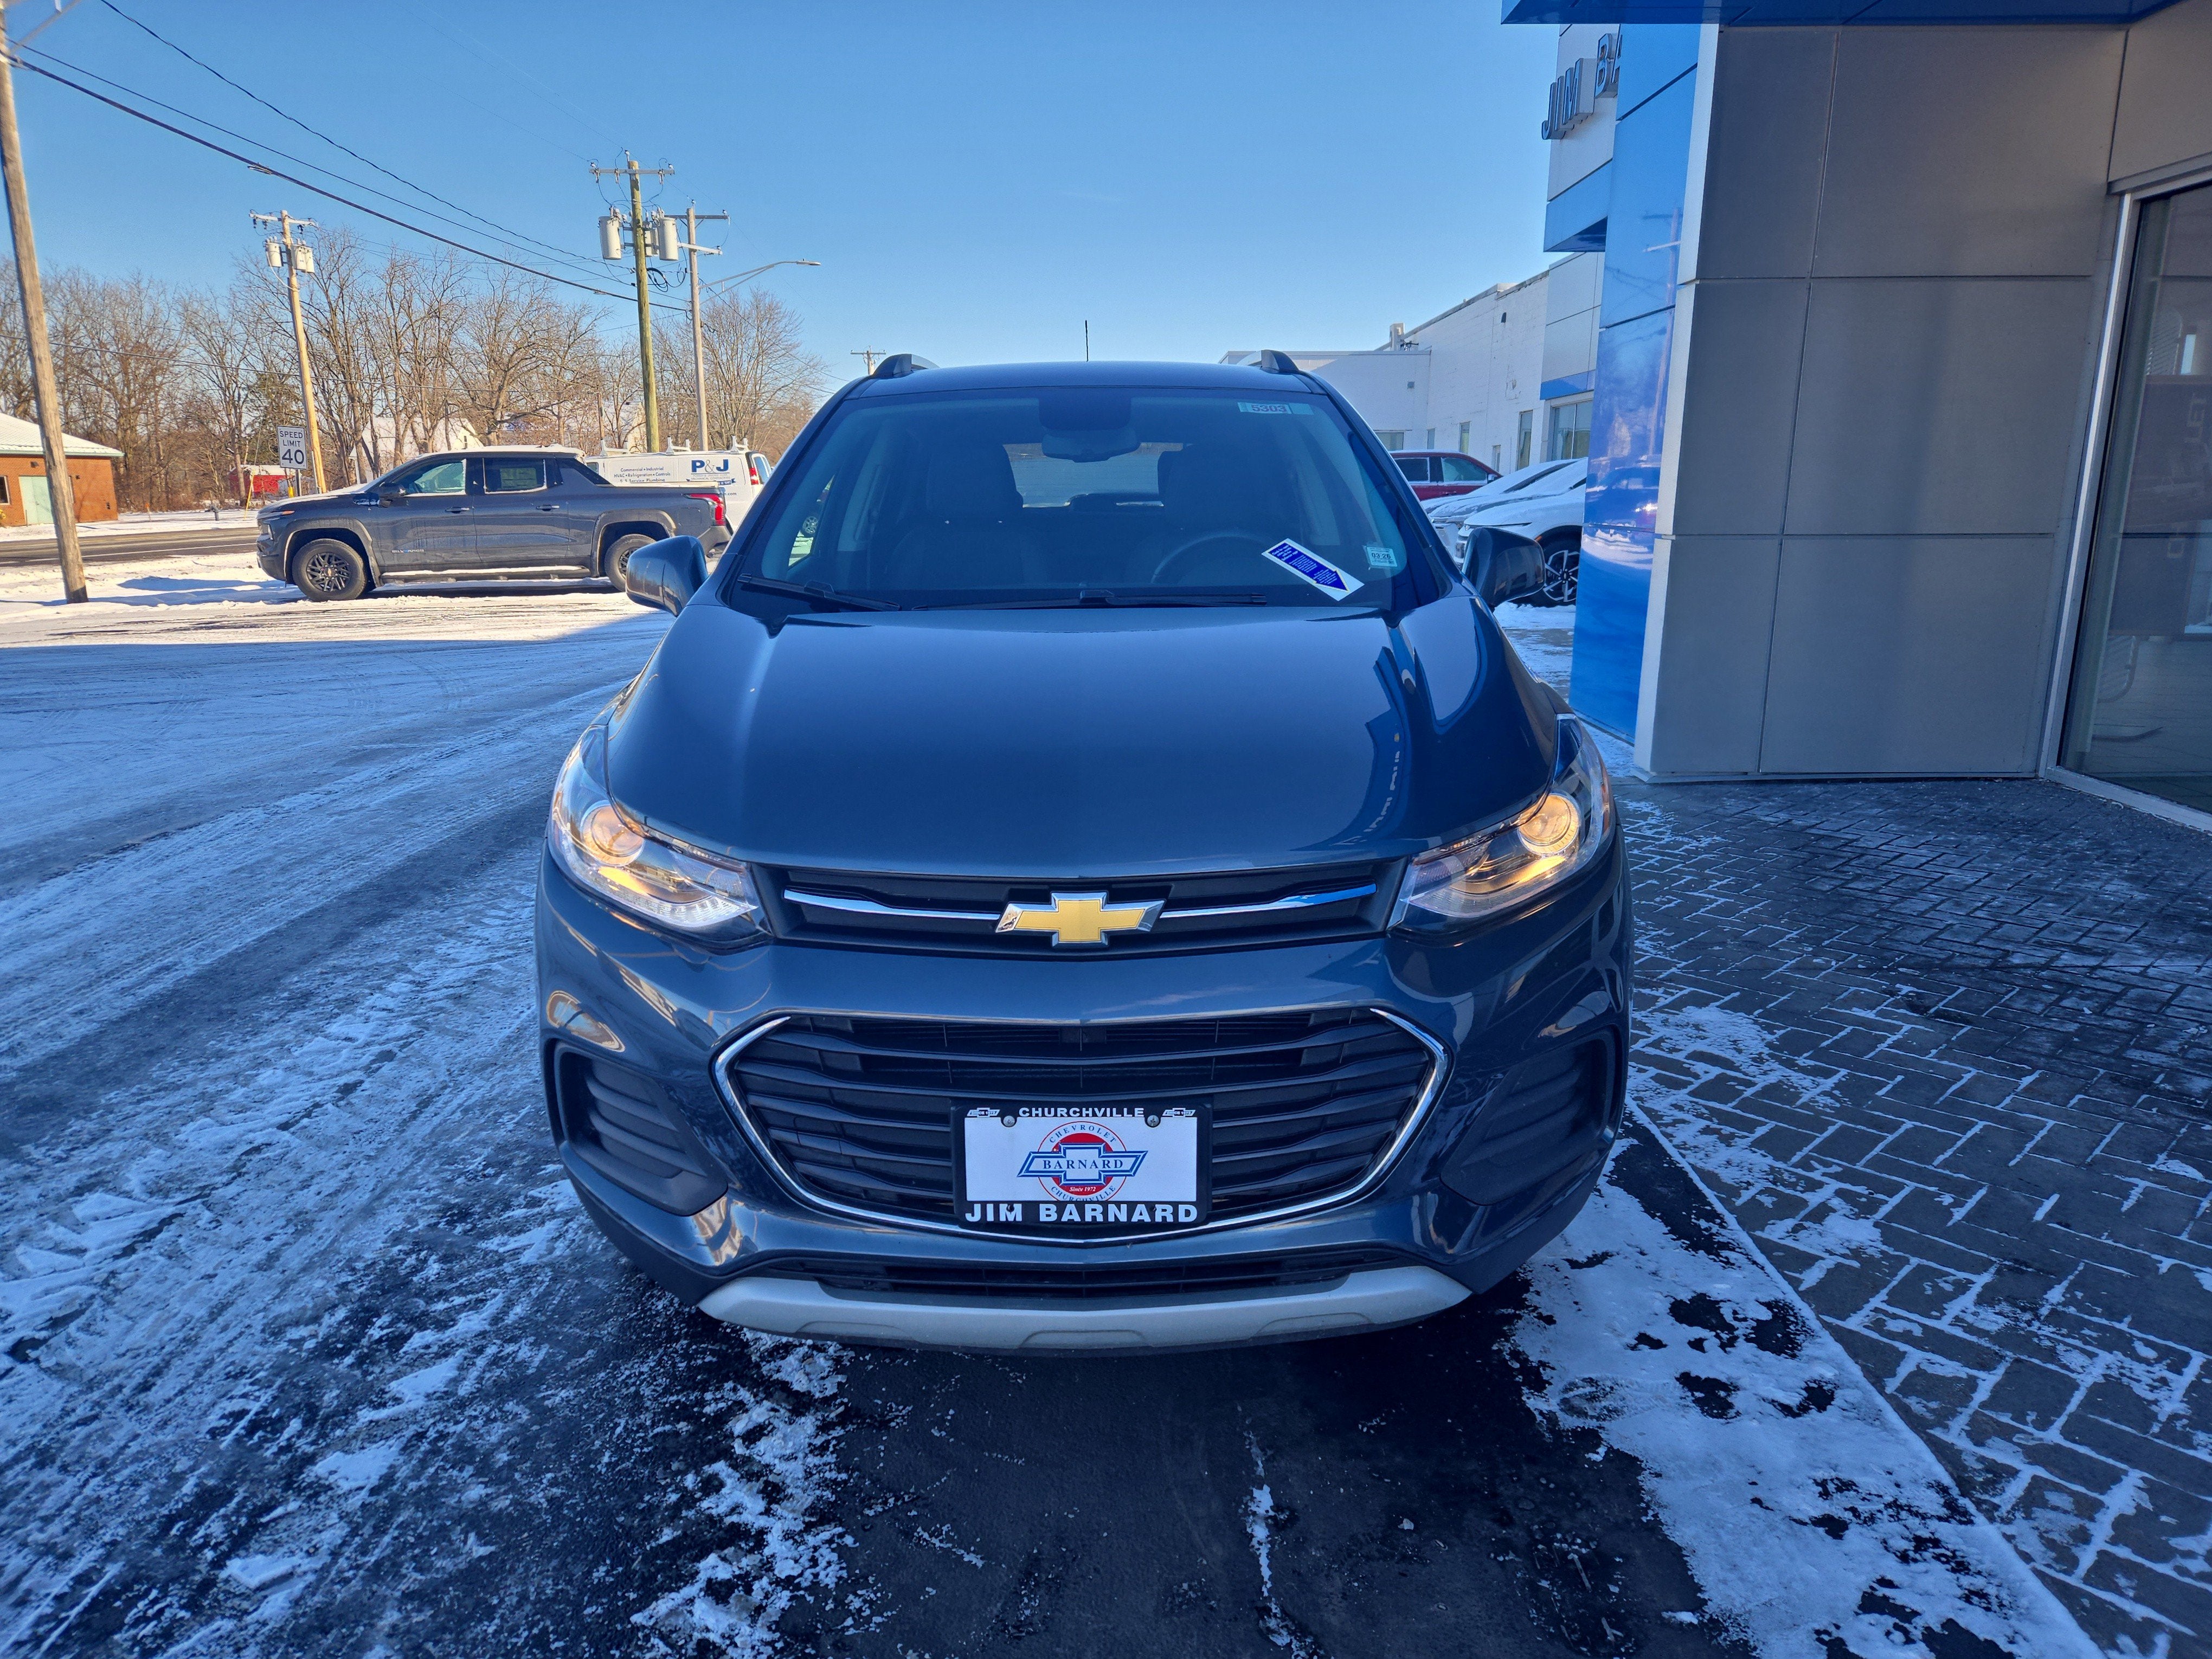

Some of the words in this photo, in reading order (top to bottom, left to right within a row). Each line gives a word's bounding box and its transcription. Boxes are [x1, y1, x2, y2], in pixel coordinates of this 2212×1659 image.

[1541, 57, 1584, 140] JIM
[1251, 404, 1288, 412] 5303
[280, 430, 303, 439] SPEED
[281, 448, 304, 465] 40
[691, 459, 729, 473] P&J
[1019, 1107, 1144, 1117] CHURCHVILLE
[1049, 1124, 1116, 1143] CHEVROLET
[1043, 1159, 1123, 1169] BARNARD
[965, 1204, 1023, 1223] JIM
[1039, 1204, 1198, 1223] BARNARD
